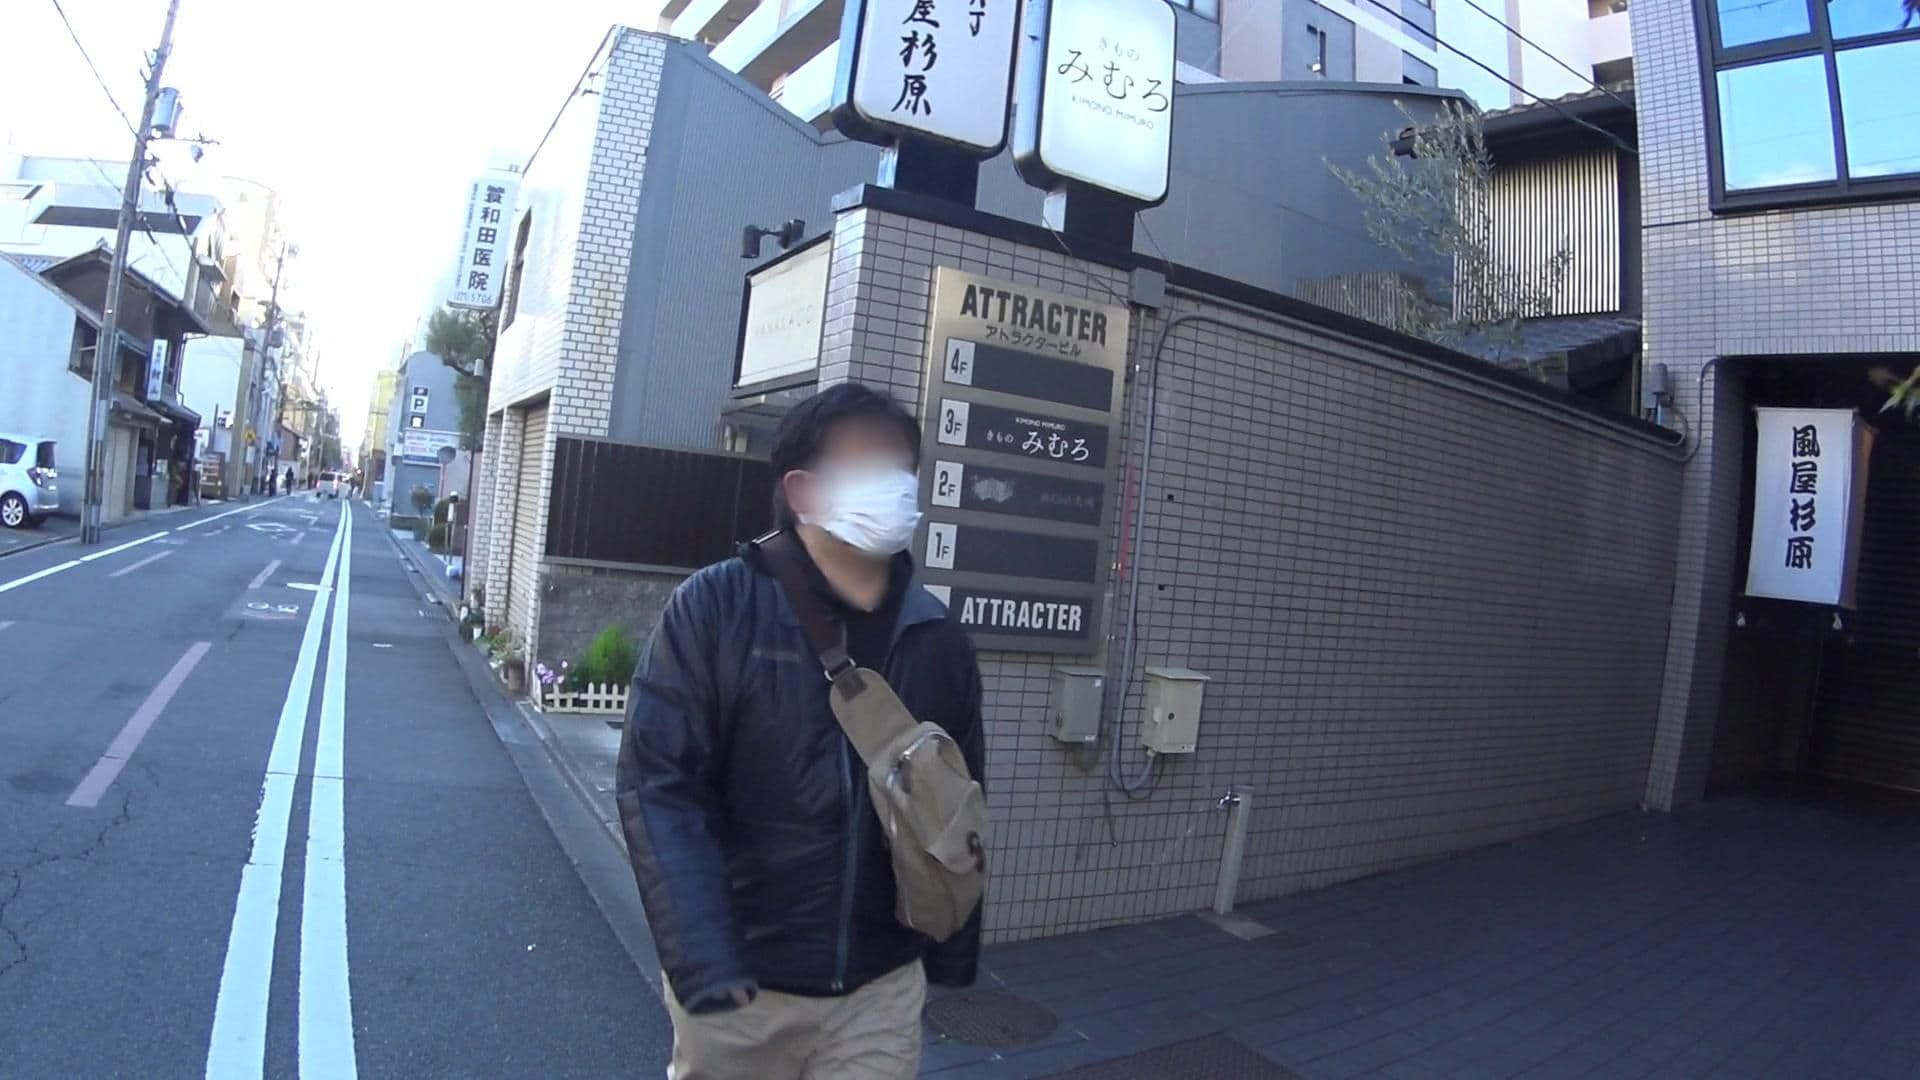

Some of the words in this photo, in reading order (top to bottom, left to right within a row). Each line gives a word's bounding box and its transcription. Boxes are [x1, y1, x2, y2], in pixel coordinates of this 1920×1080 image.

[969, 0, 986, 37] 丁
[1099, 36, 1140, 61] きもの
[1057, 49, 1169, 112] みむろ
[960, 284, 1107, 347] ATTRACTER
[985, 325, 1082, 358] アトラクタービル
[950, 348, 968, 375] 4F
[945, 409, 962, 436] 3F
[1022, 432, 1089, 461] みむろ
[938, 470, 956, 497] 2F
[1785, 424, 1820, 569] 風屋杉原
[935, 532, 950, 560] 1F
[960, 596, 1082, 632] ATTRACTER
